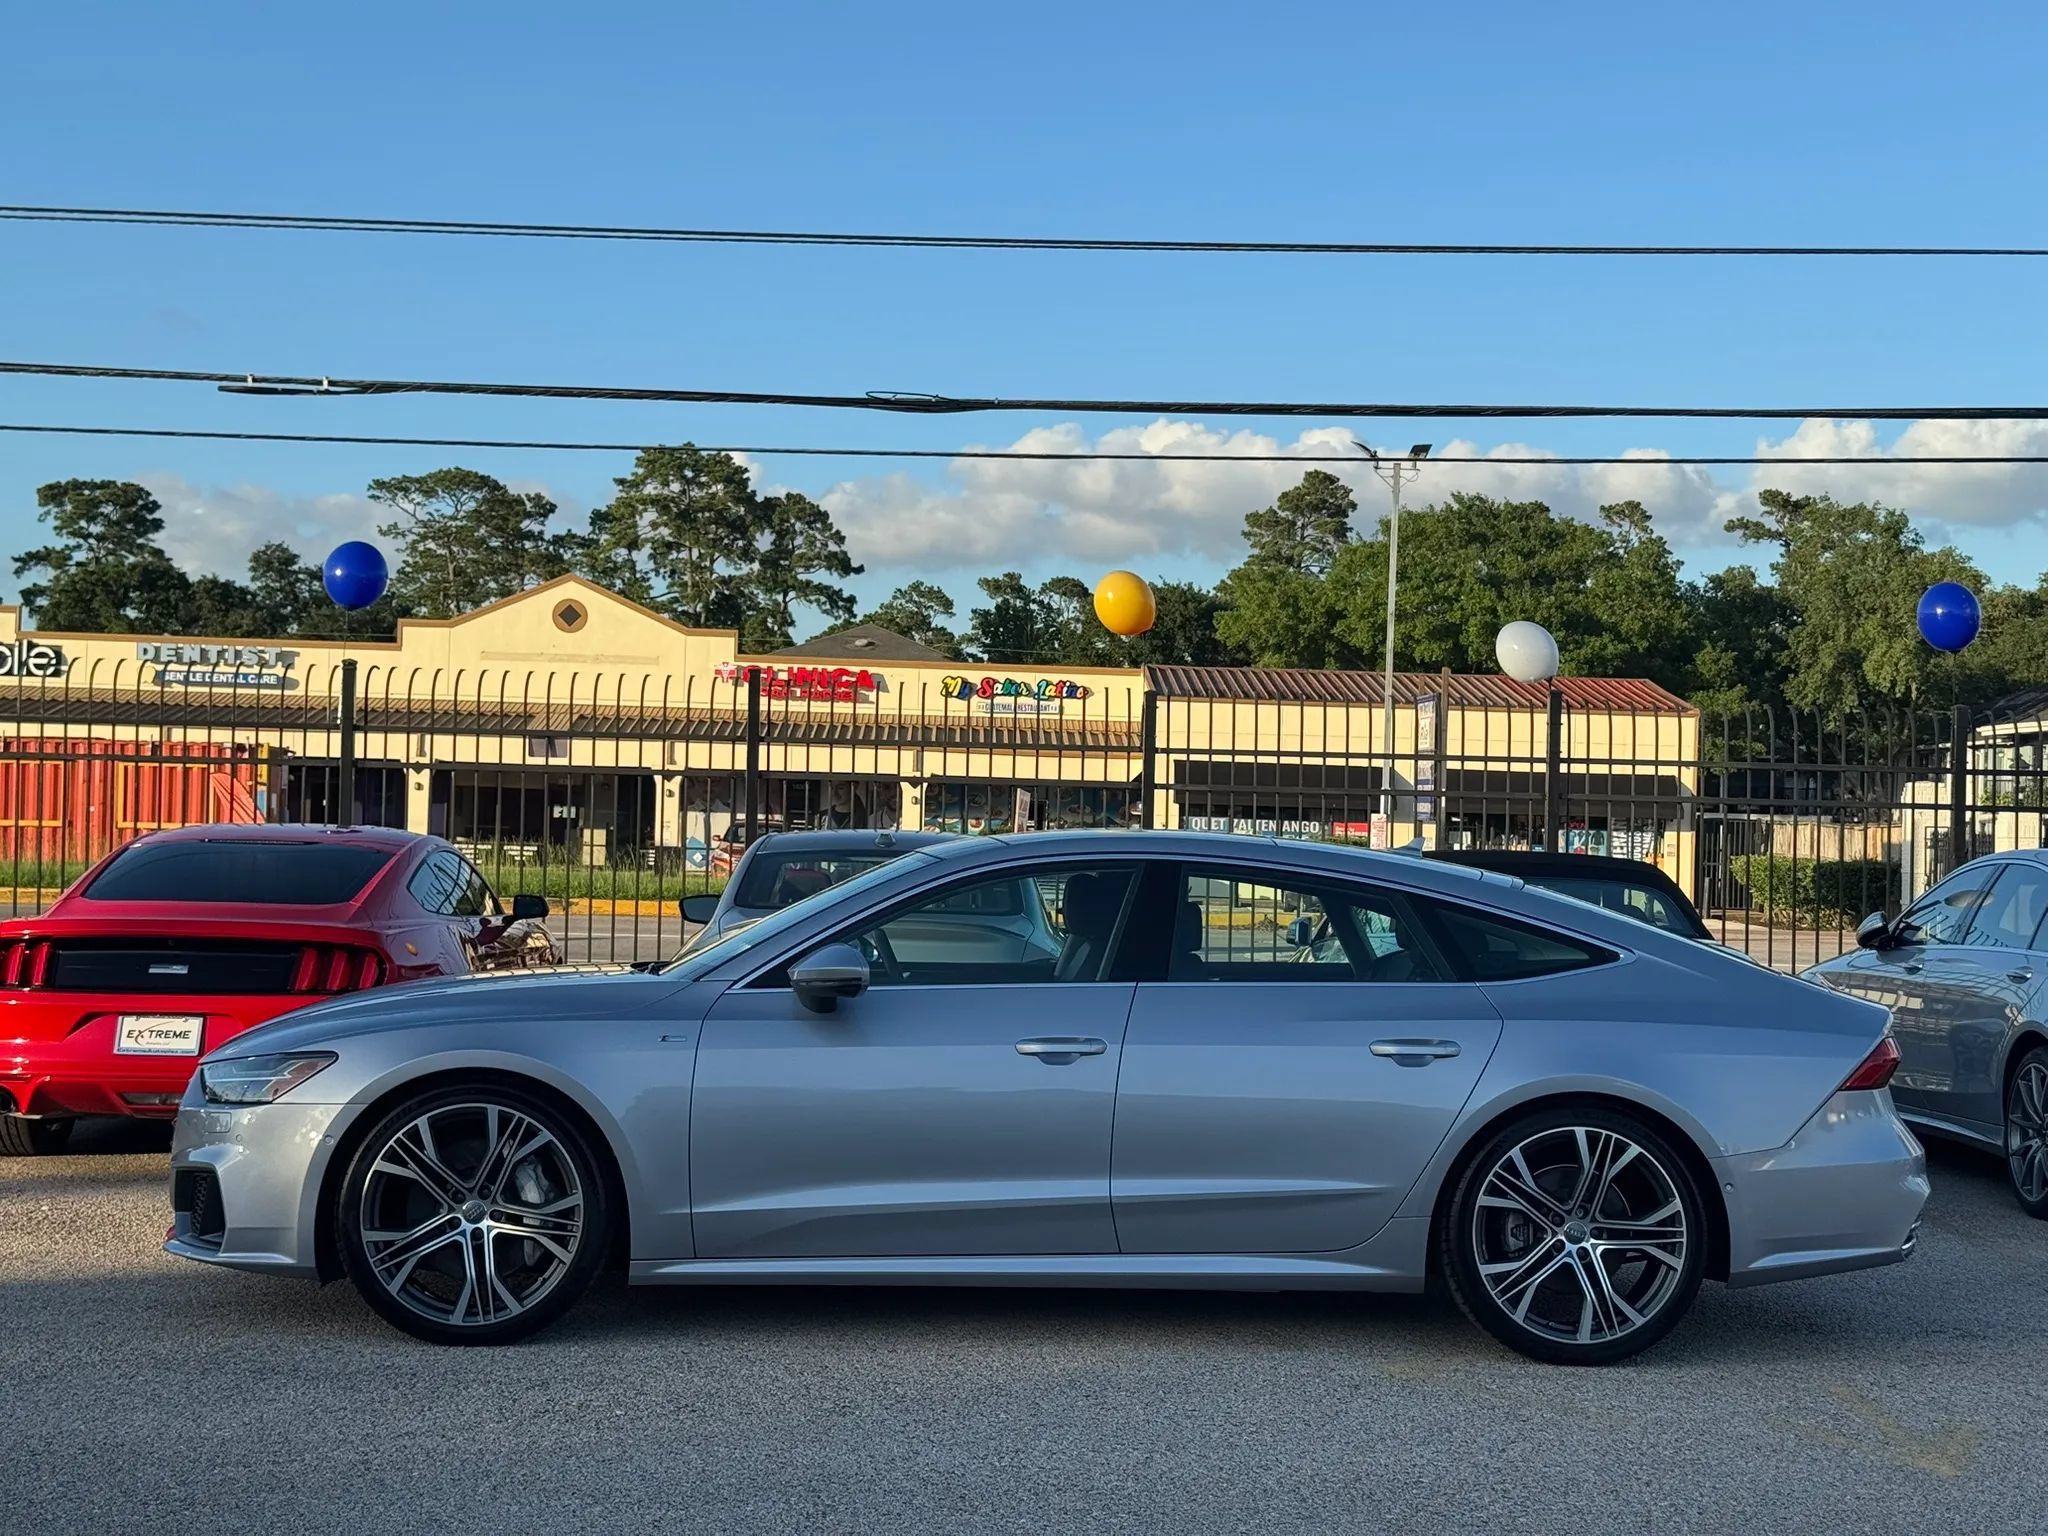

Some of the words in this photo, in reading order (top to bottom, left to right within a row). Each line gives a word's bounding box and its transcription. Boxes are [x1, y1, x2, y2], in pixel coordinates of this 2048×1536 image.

[137, 642, 281, 666] DENTIST
[247, 674, 278, 685] CARE
[976, 677, 1030, 699] Sabor
[1033, 678, 1090, 700] Latino
[126, 1029, 192, 1039] EXTREME
